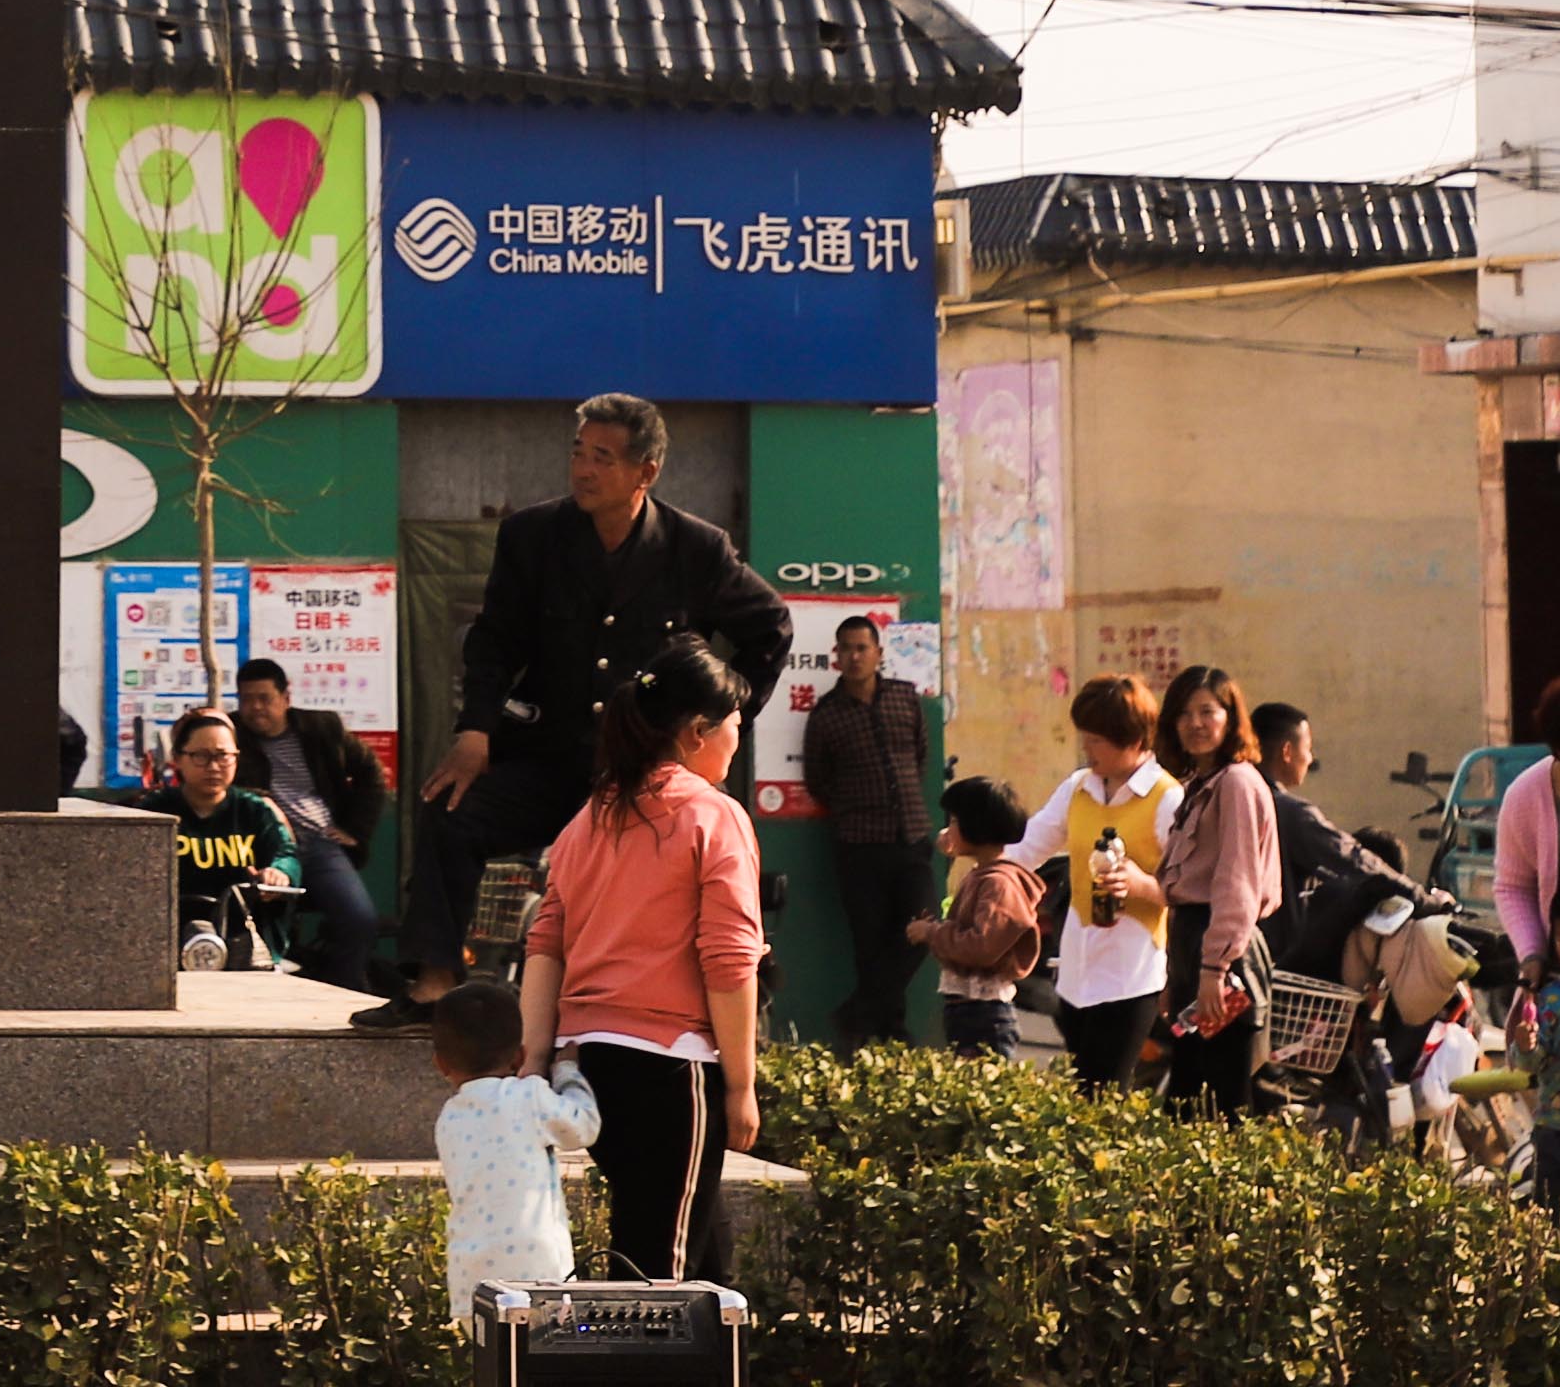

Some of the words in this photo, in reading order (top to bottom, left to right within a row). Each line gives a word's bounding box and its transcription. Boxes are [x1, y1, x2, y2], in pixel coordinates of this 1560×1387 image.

[488, 204, 649, 246] 中国移动
[673, 212, 919, 274] 飞虎通讯
[488, 248, 563, 274] China
[567, 249, 648, 275] Mobile
[286, 590, 361, 607] 中国移动
[176, 834, 256, 869] PUNK
